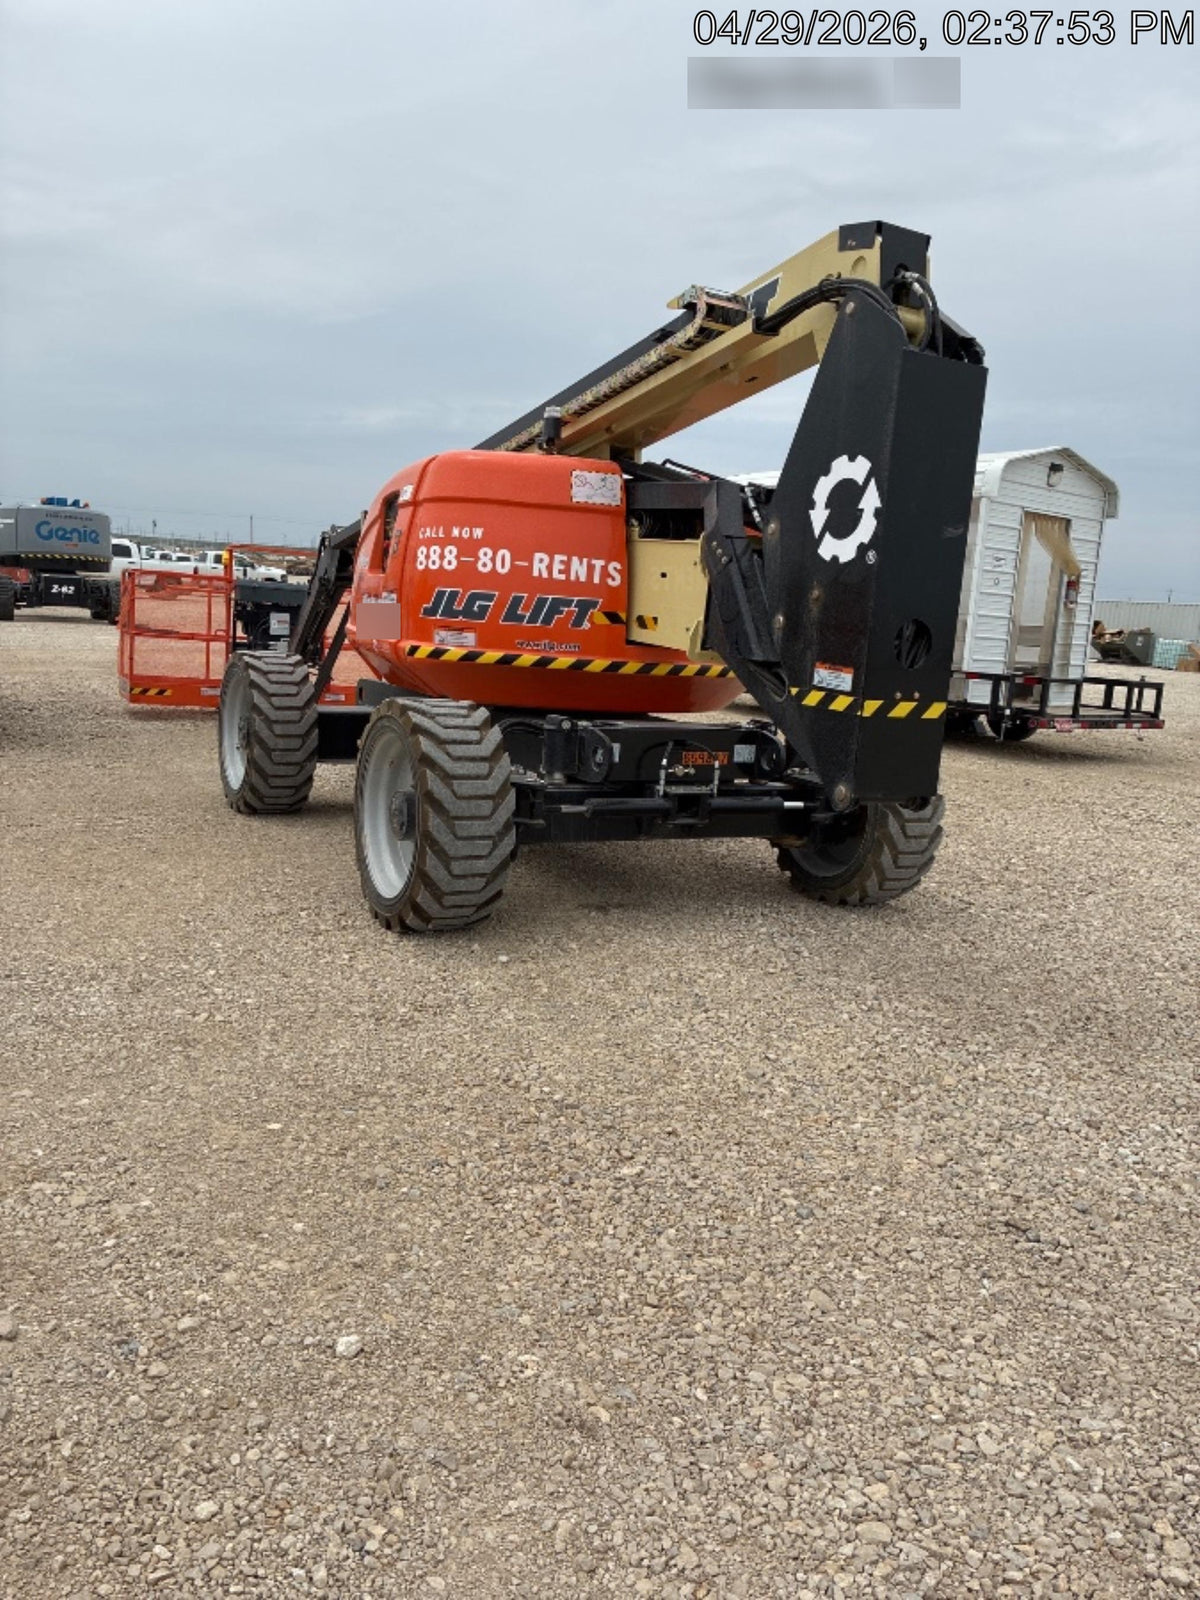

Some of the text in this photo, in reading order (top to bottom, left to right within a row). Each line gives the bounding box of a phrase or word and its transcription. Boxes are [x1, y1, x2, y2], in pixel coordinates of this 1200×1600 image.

[35, 520, 99, 544] Genie
[418, 527, 484, 540] CALL NOW
[416, 545, 622, 586] 888-80-RENTS
[419, 588, 602, 629] JLG LIFT
